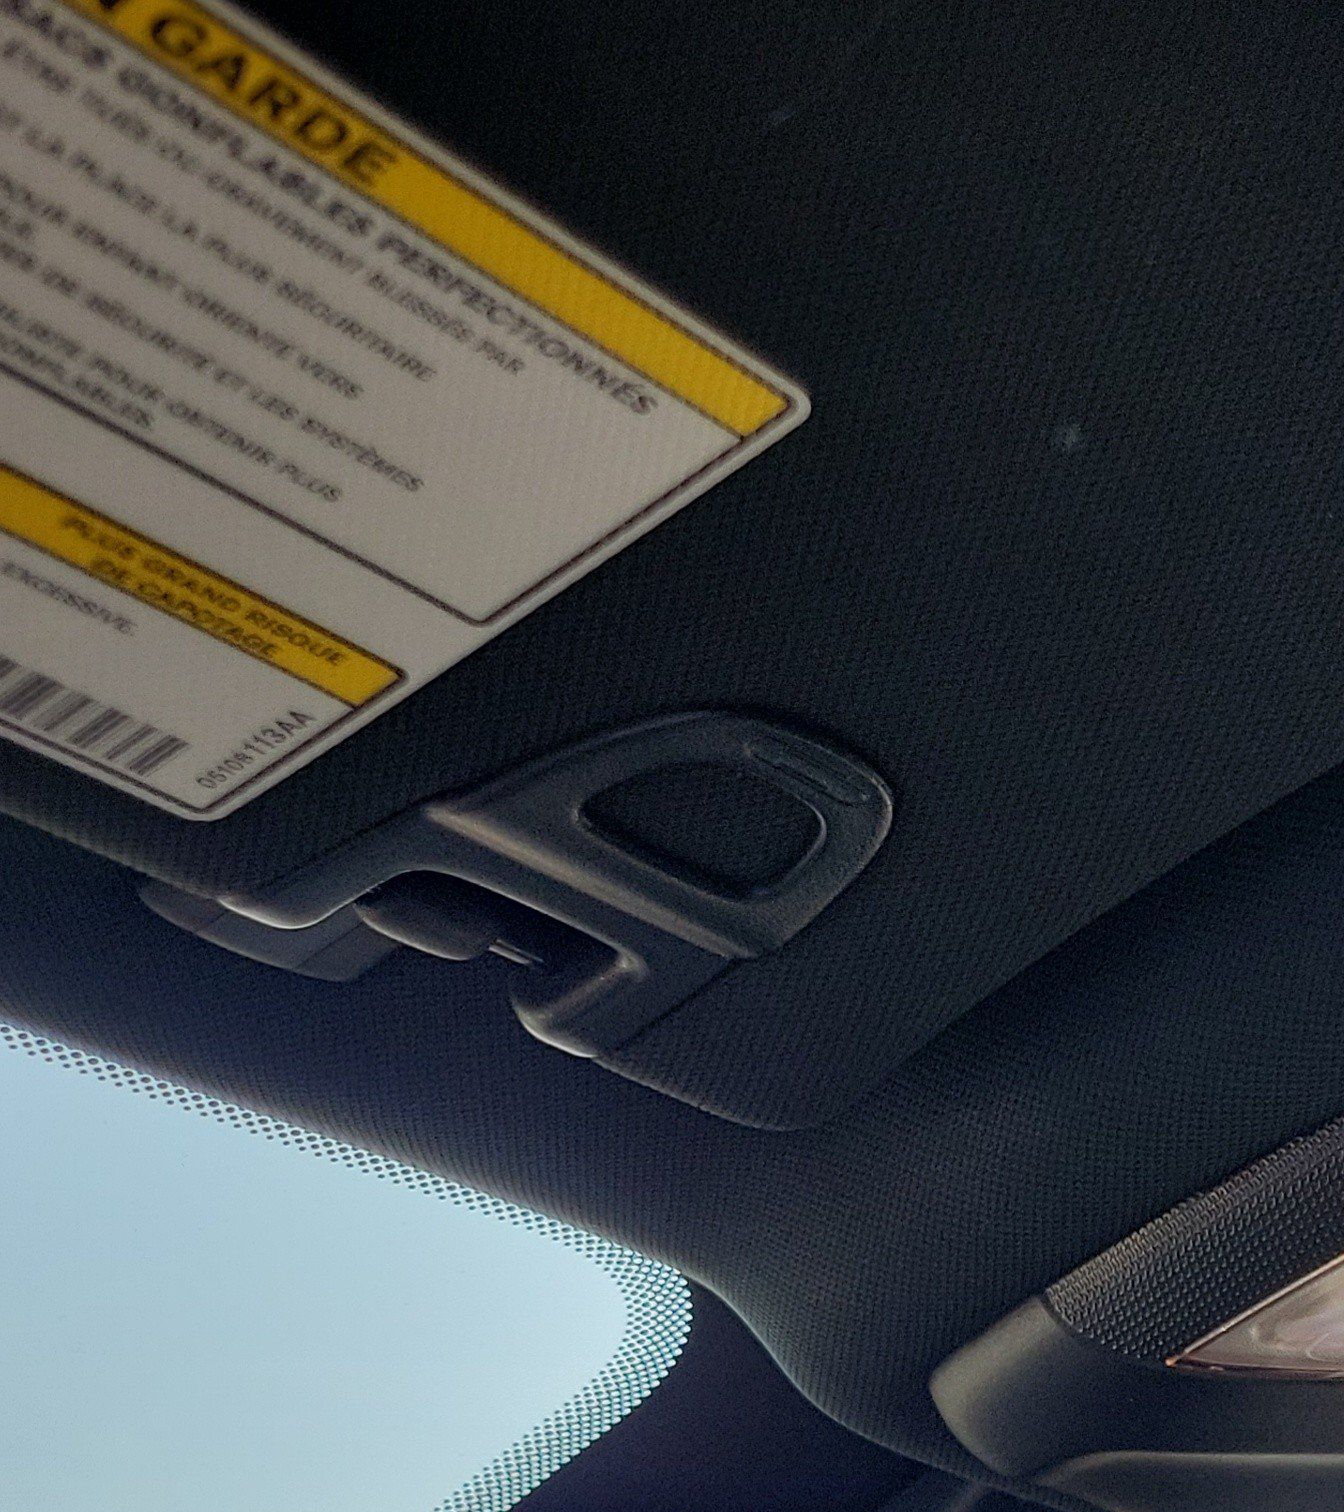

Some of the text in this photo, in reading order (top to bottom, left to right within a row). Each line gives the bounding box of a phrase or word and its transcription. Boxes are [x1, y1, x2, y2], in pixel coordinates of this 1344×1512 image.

[149, 13, 397, 182] GARDE
[376, 234, 658, 414] PERFECTIONNÉS
[475, 341, 524, 374] PAR
[276, 462, 340, 501] PLUS
[137, 580, 278, 657] CAPOTAGE
[142, 557, 238, 612] GRAND
[244, 609, 342, 665] RISQUE
